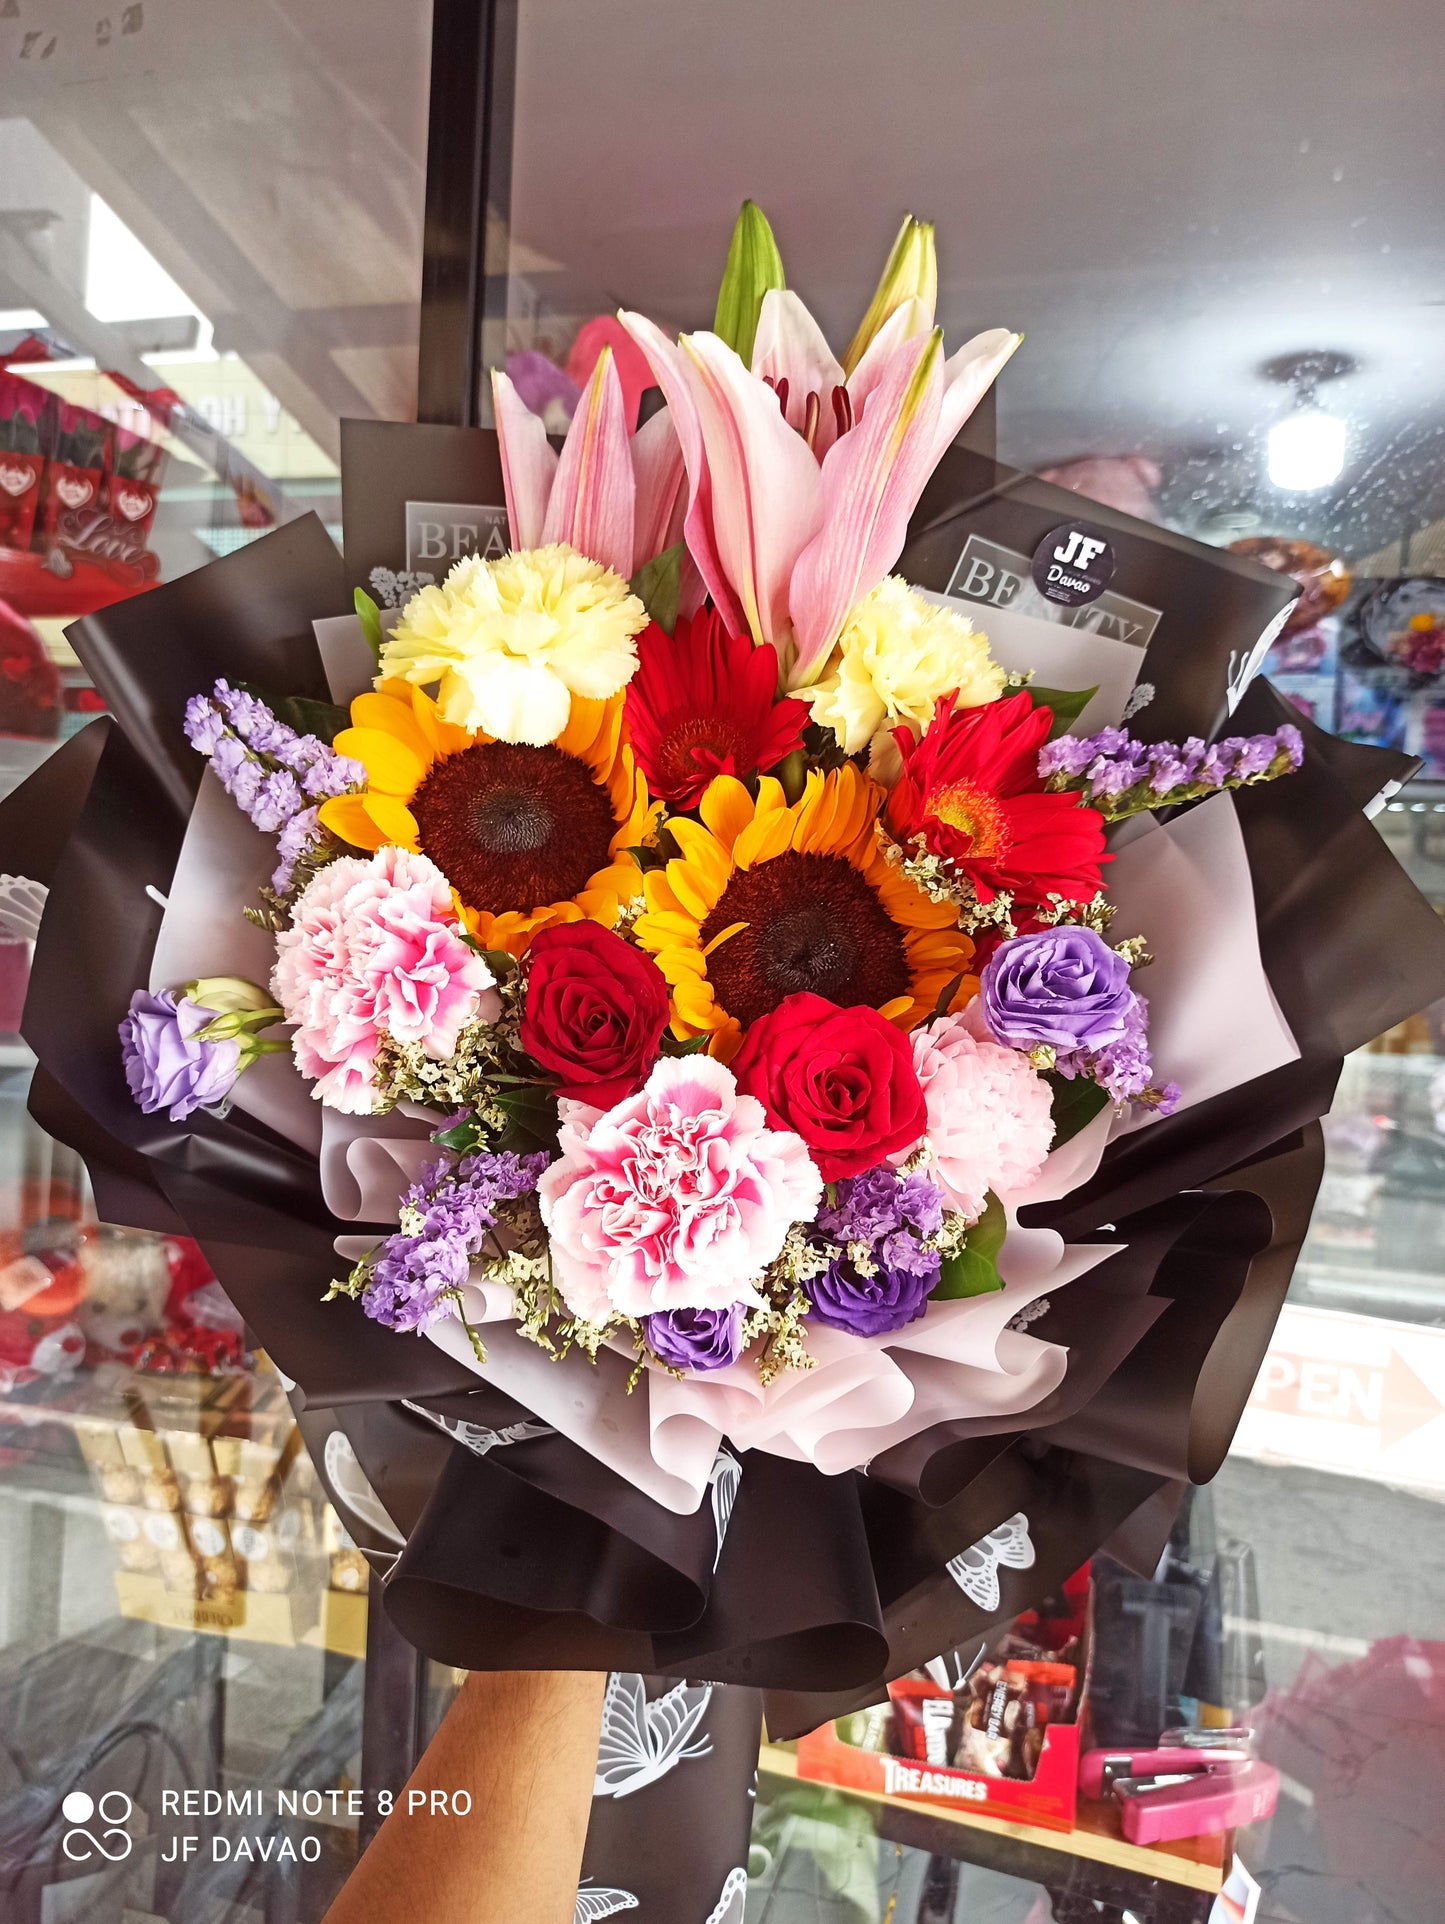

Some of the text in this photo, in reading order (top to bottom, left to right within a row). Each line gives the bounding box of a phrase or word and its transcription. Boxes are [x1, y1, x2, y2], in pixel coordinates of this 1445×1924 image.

[1053, 531, 1107, 571] JF
[1046, 564, 1091, 593] Davao
[1254, 1356, 1384, 1422] PEN
